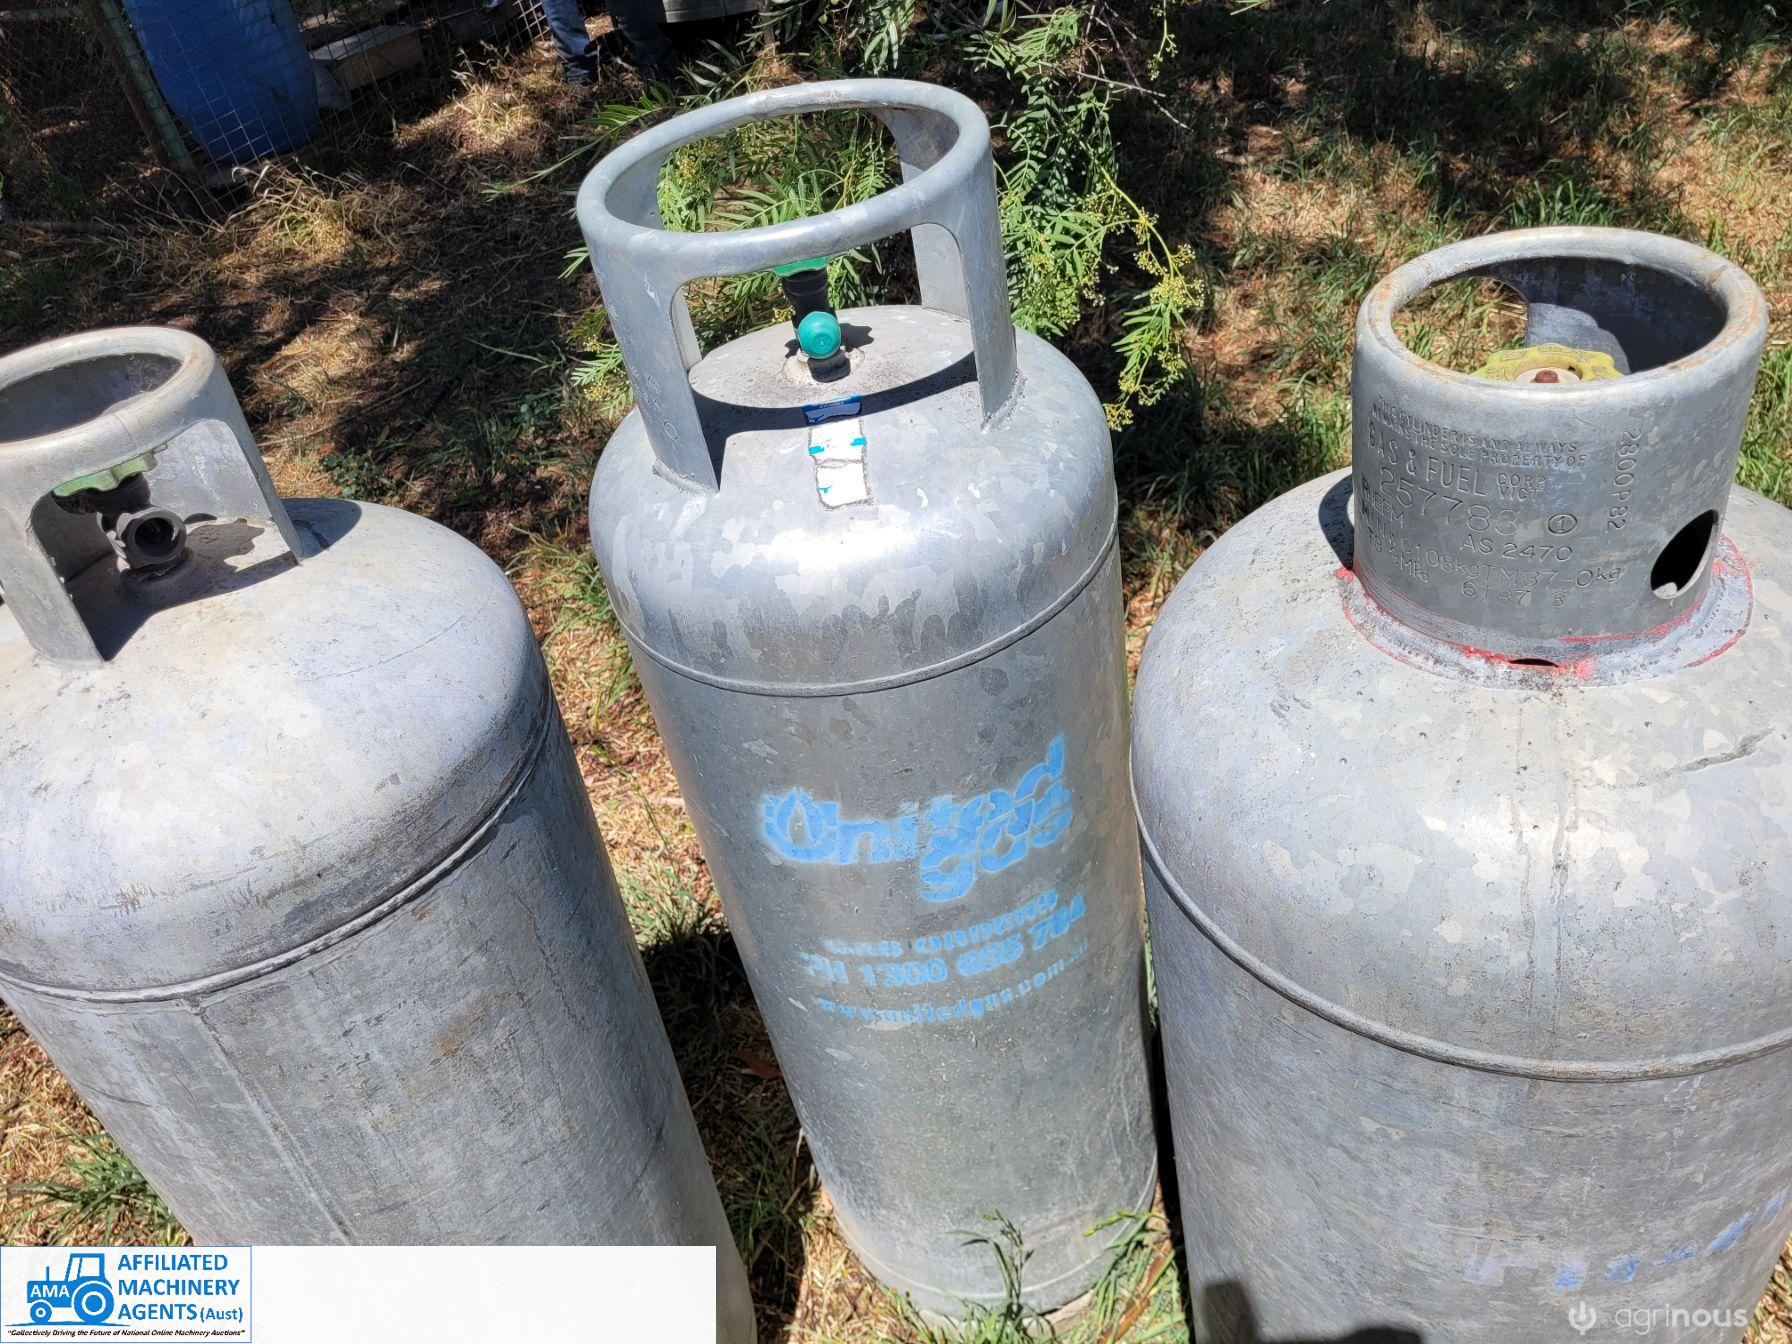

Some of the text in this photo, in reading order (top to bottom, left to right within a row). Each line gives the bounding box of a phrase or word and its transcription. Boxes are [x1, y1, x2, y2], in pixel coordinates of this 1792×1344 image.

[1399, 410, 1462, 443] CYLINDER
[1440, 442, 1476, 461] SOLE
[1479, 449, 1563, 468] PROPERTY
[1566, 453, 1588, 468] OF
[1405, 448, 1418, 474] &
[1424, 456, 1488, 498] FUEL
[1496, 471, 1547, 490] CORP
[1361, 471, 1405, 529] RHEEM
[1378, 466, 1519, 536] 257783
[1498, 486, 1545, 502] VICT
[1459, 532, 1574, 563] AS 2470
[859, 957, 949, 989] 1300
